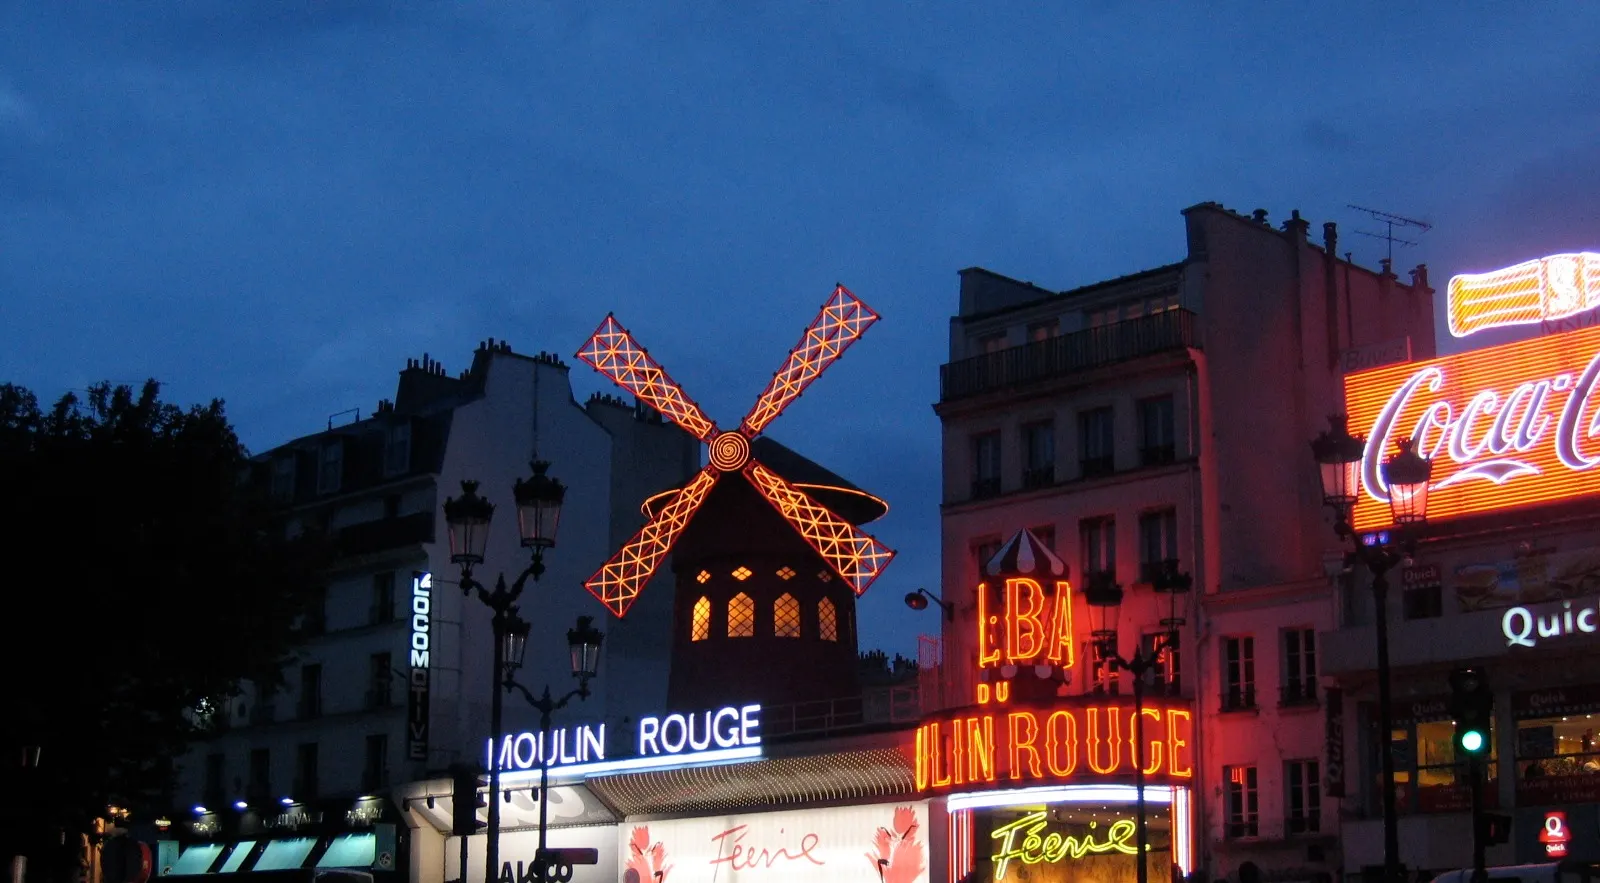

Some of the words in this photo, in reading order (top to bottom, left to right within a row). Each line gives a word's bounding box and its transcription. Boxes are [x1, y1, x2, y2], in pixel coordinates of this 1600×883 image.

[1361, 351, 1600, 502] Coca-C
[1404, 566, 1438, 583] Quick
[1501, 600, 1600, 648] Quic
[410, 577, 431, 759] LOCOMOTIVE
[977, 681, 1008, 704] DU
[487, 723, 606, 771] MOULIN
[640, 704, 761, 755] ROUGE
[1008, 707, 1192, 780] ROUGE
[1545, 816, 1564, 837] Q
[1545, 843, 1566, 853] Quick
